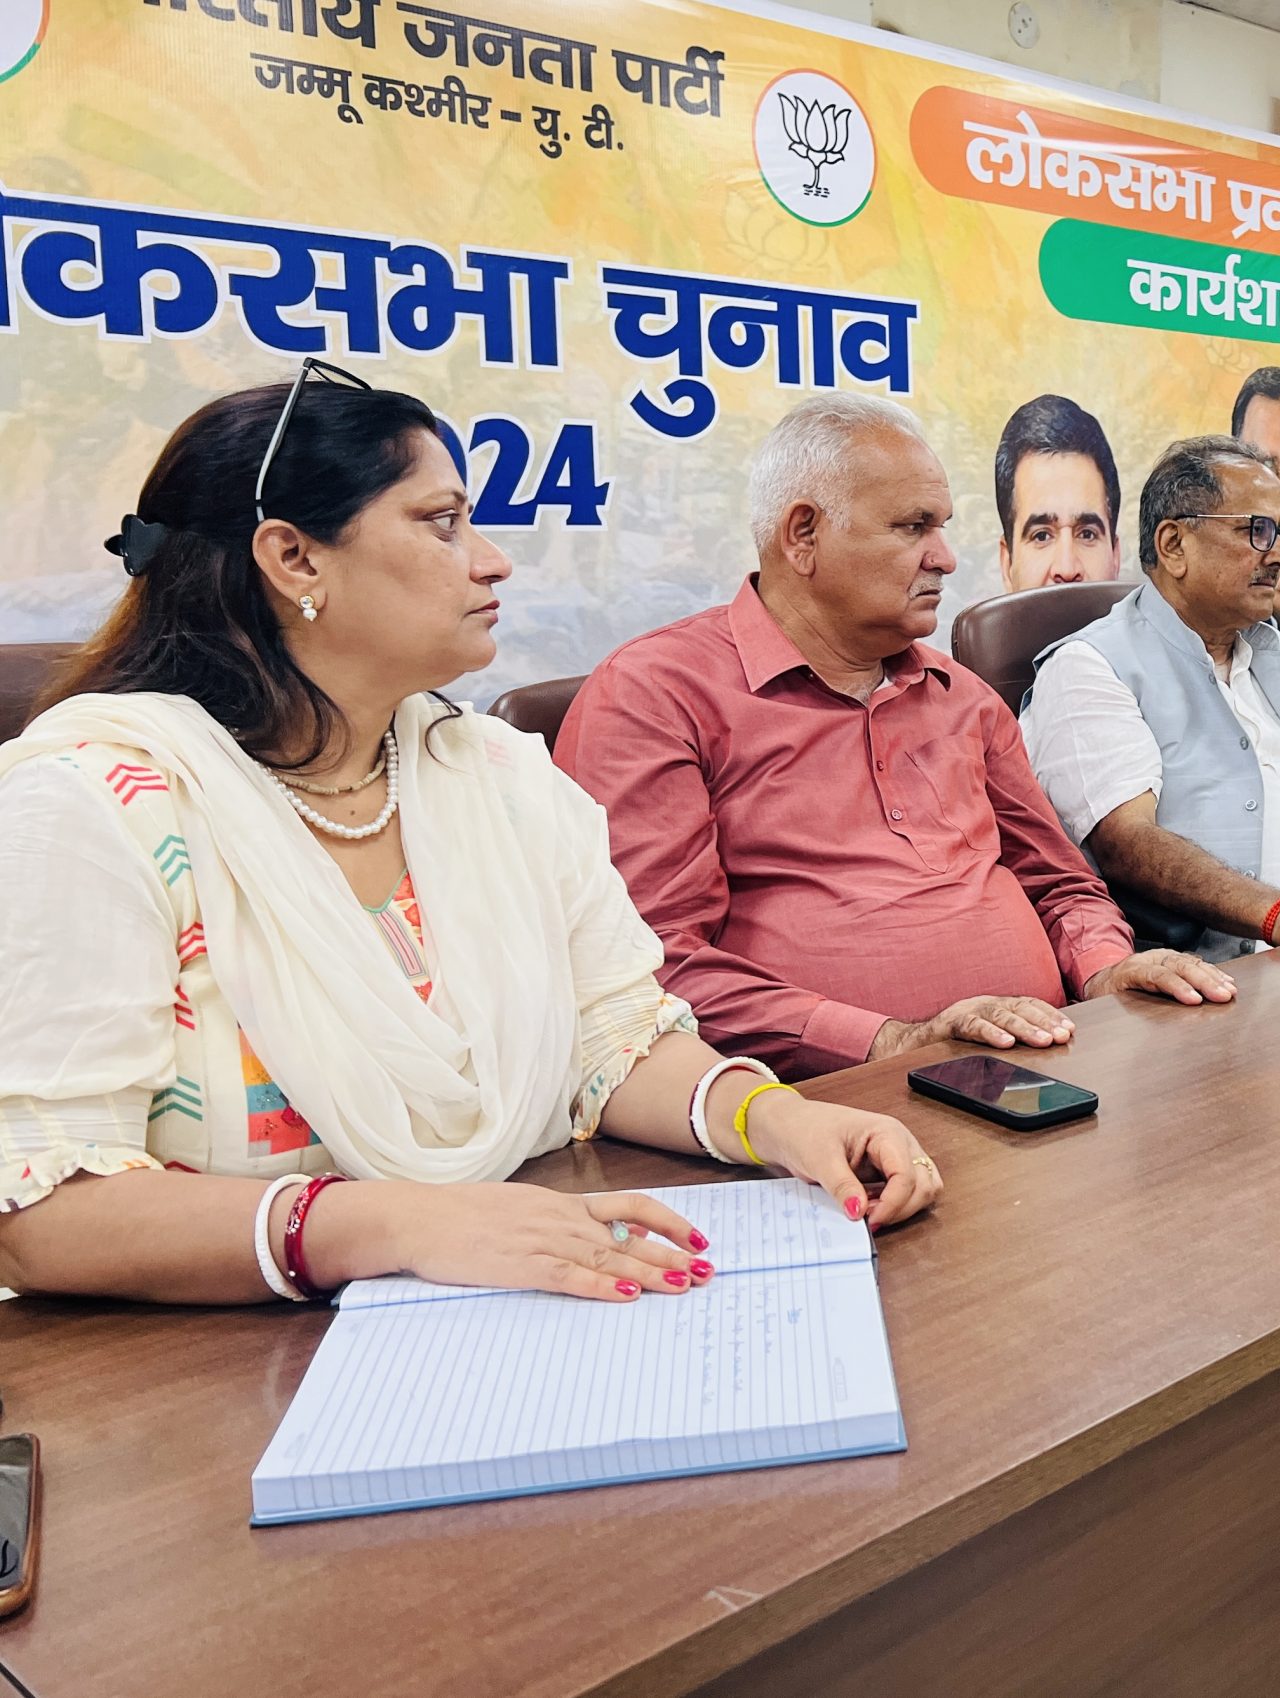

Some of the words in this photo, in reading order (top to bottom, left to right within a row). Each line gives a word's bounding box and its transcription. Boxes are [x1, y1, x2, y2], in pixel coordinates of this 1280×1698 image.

[250, 52, 363, 125] जम्मू
[362, 75, 492, 129] कश्मीर
[396, 1, 597, 93] जनता
[611, 45, 725, 118] पार्टी
[963, 110, 1216, 224] लोकसभा
[0, 193, 570, 368] कसभा
[602, 266, 918, 438] चुनाव
[435, 416, 610, 526] 24
